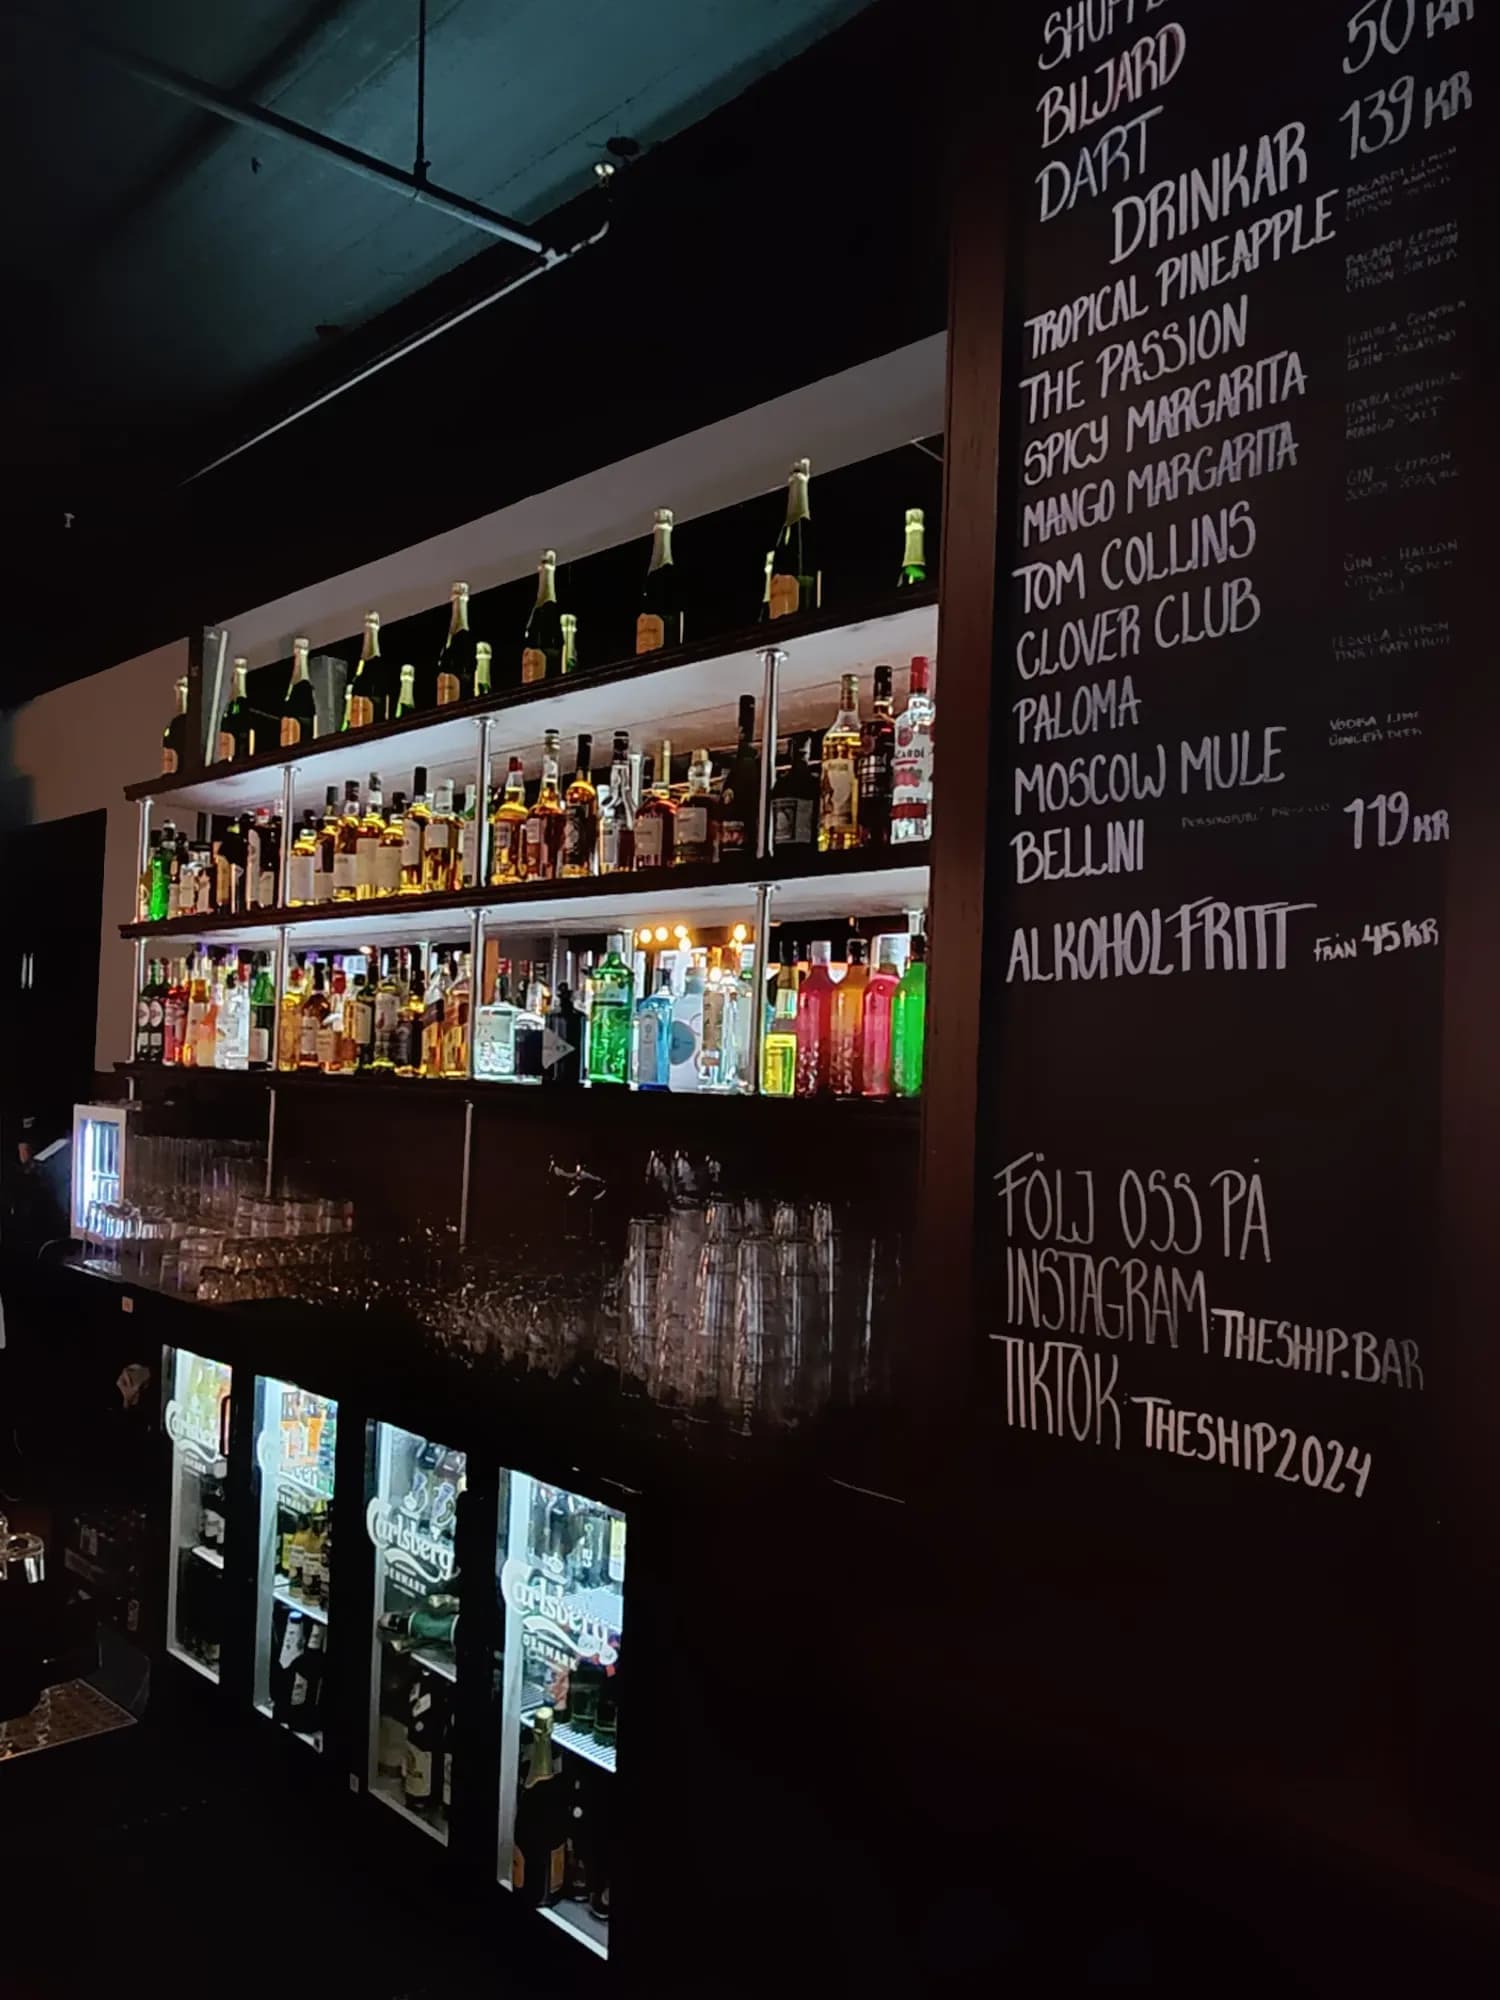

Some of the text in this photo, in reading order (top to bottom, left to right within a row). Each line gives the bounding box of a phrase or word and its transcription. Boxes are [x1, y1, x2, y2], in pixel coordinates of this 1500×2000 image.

[1036, 22, 1186, 148] BILJARD
[1342, 0, 1415, 74] 50
[1035, 105, 1164, 222] DART
[1338, 70, 1473, 160] 139 KR
[1109, 121, 1307, 264] DRINKAR
[1024, 189, 1339, 360] TROPICAL PINEAPPLE
[1019, 295, 1248, 424] THE PASSION
[1023, 351, 1307, 486] SPICY MARGARITA
[1022, 421, 1299, 547] MANGO MARGARITA
[1012, 501, 1256, 614] TOM COLLINS
[1016, 577, 1261, 680] CLOVER CLUB
[1012, 676, 1142, 744] PALOMA
[1014, 726, 1287, 815] MOSCOW MULE
[1343, 791, 1450, 849] 119 KR
[1010, 819, 1144, 884] BELLINI
[994, 1152, 1271, 1263] FÖLJ OSS PÅ
[1211, 1308, 1424, 1391] THESHIP.BAR
[1131, 1396, 1372, 1498] THESHIP2024
[366, 1497, 458, 1581] Carlsberg
[501, 1558, 615, 1663] Carlsberg
[521, 1634, 578, 1672] DENMARK
